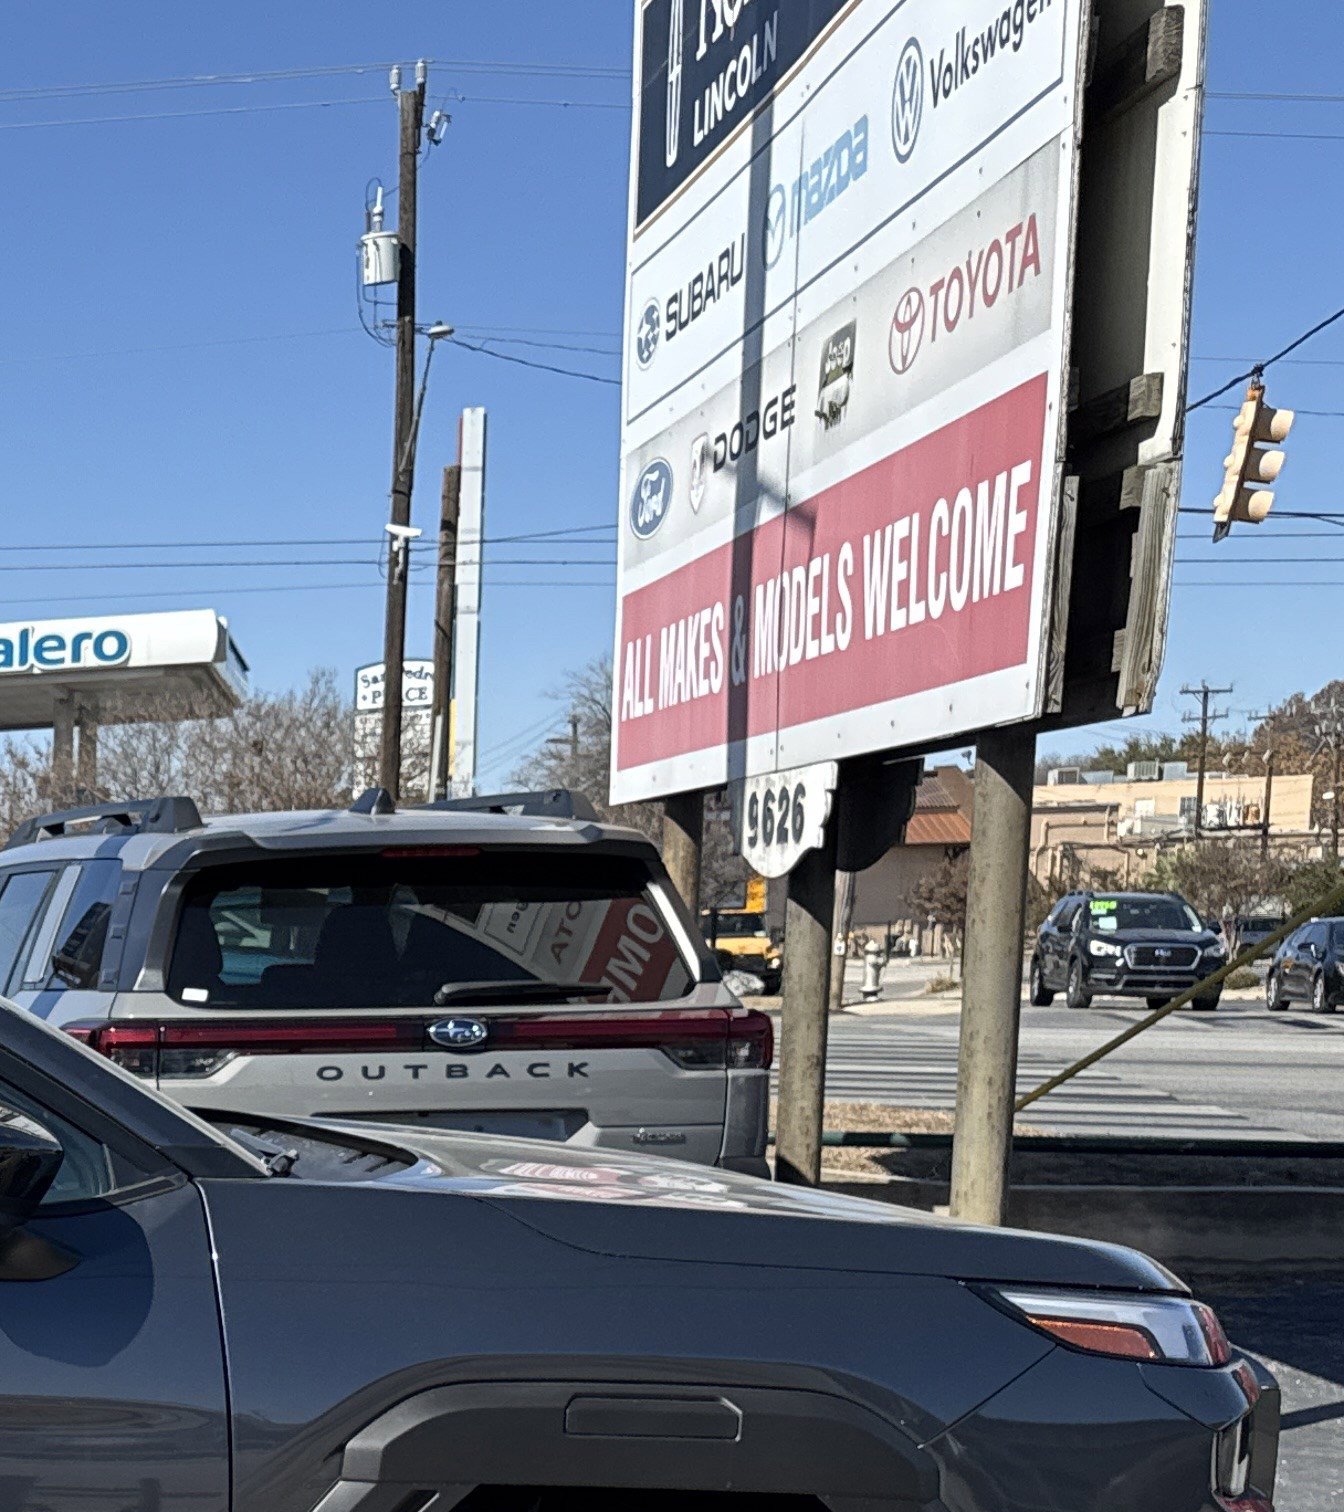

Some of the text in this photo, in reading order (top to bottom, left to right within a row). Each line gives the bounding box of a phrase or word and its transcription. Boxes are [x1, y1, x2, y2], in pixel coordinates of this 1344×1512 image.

[693, 9, 779, 147] LINCOLN
[665, 233, 745, 342] SUBARU
[929, 212, 1041, 343] TOYOTA
[713, 384, 797, 473] DODGE
[621, 459, 1032, 722] ALL MAKES & MODELS WELCOME
[371, 686, 429, 705] PCE
[747, 781, 807, 849] 9626
[315, 1061, 590, 1082] OUTBACK
